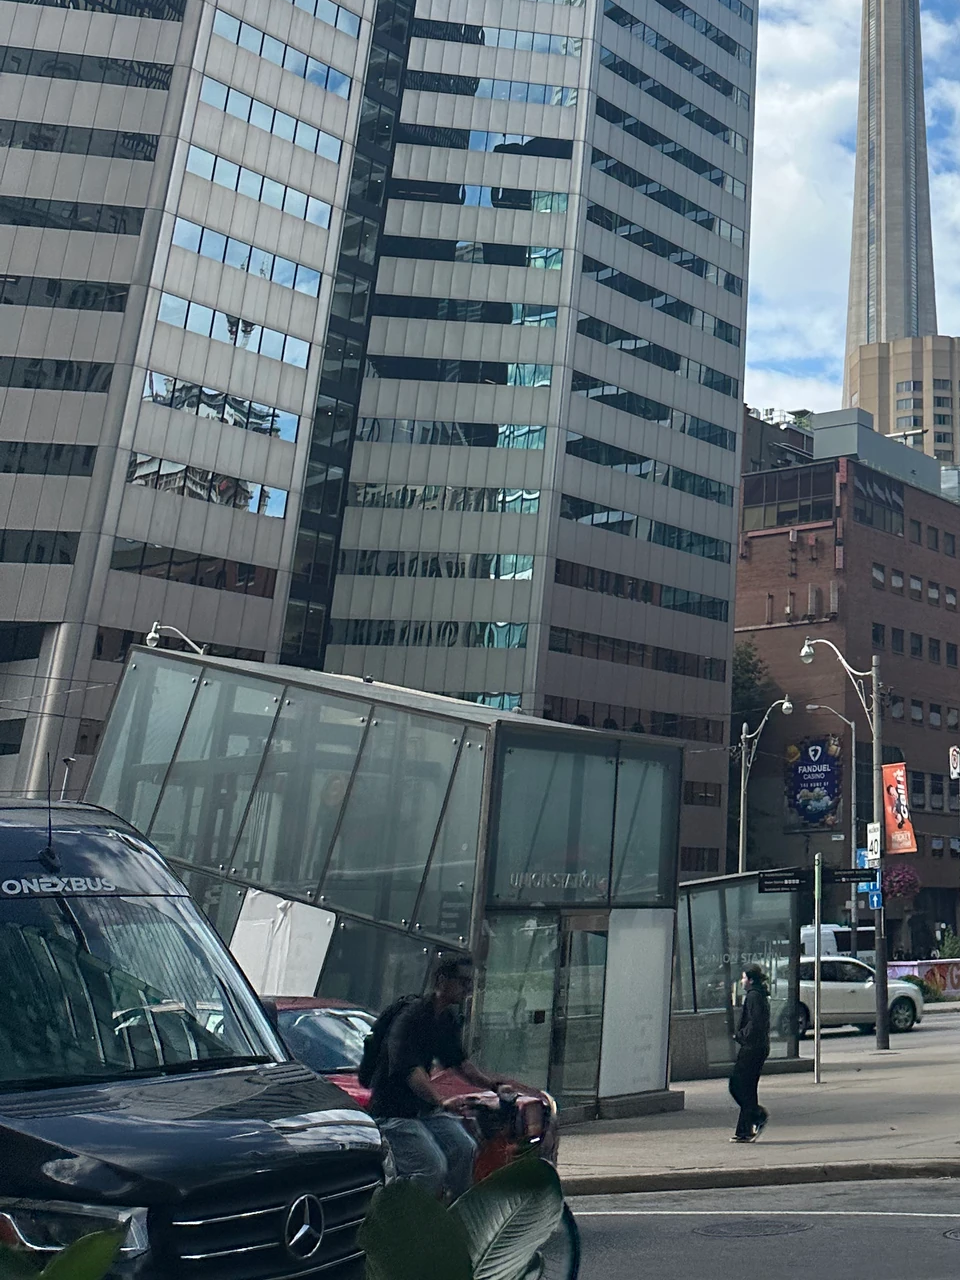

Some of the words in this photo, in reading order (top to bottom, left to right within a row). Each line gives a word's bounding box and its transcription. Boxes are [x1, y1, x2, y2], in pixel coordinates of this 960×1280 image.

[798, 764, 832, 774] FANDUEL
[803, 772, 825, 780] CASINO
[869, 838, 879, 855] 40
